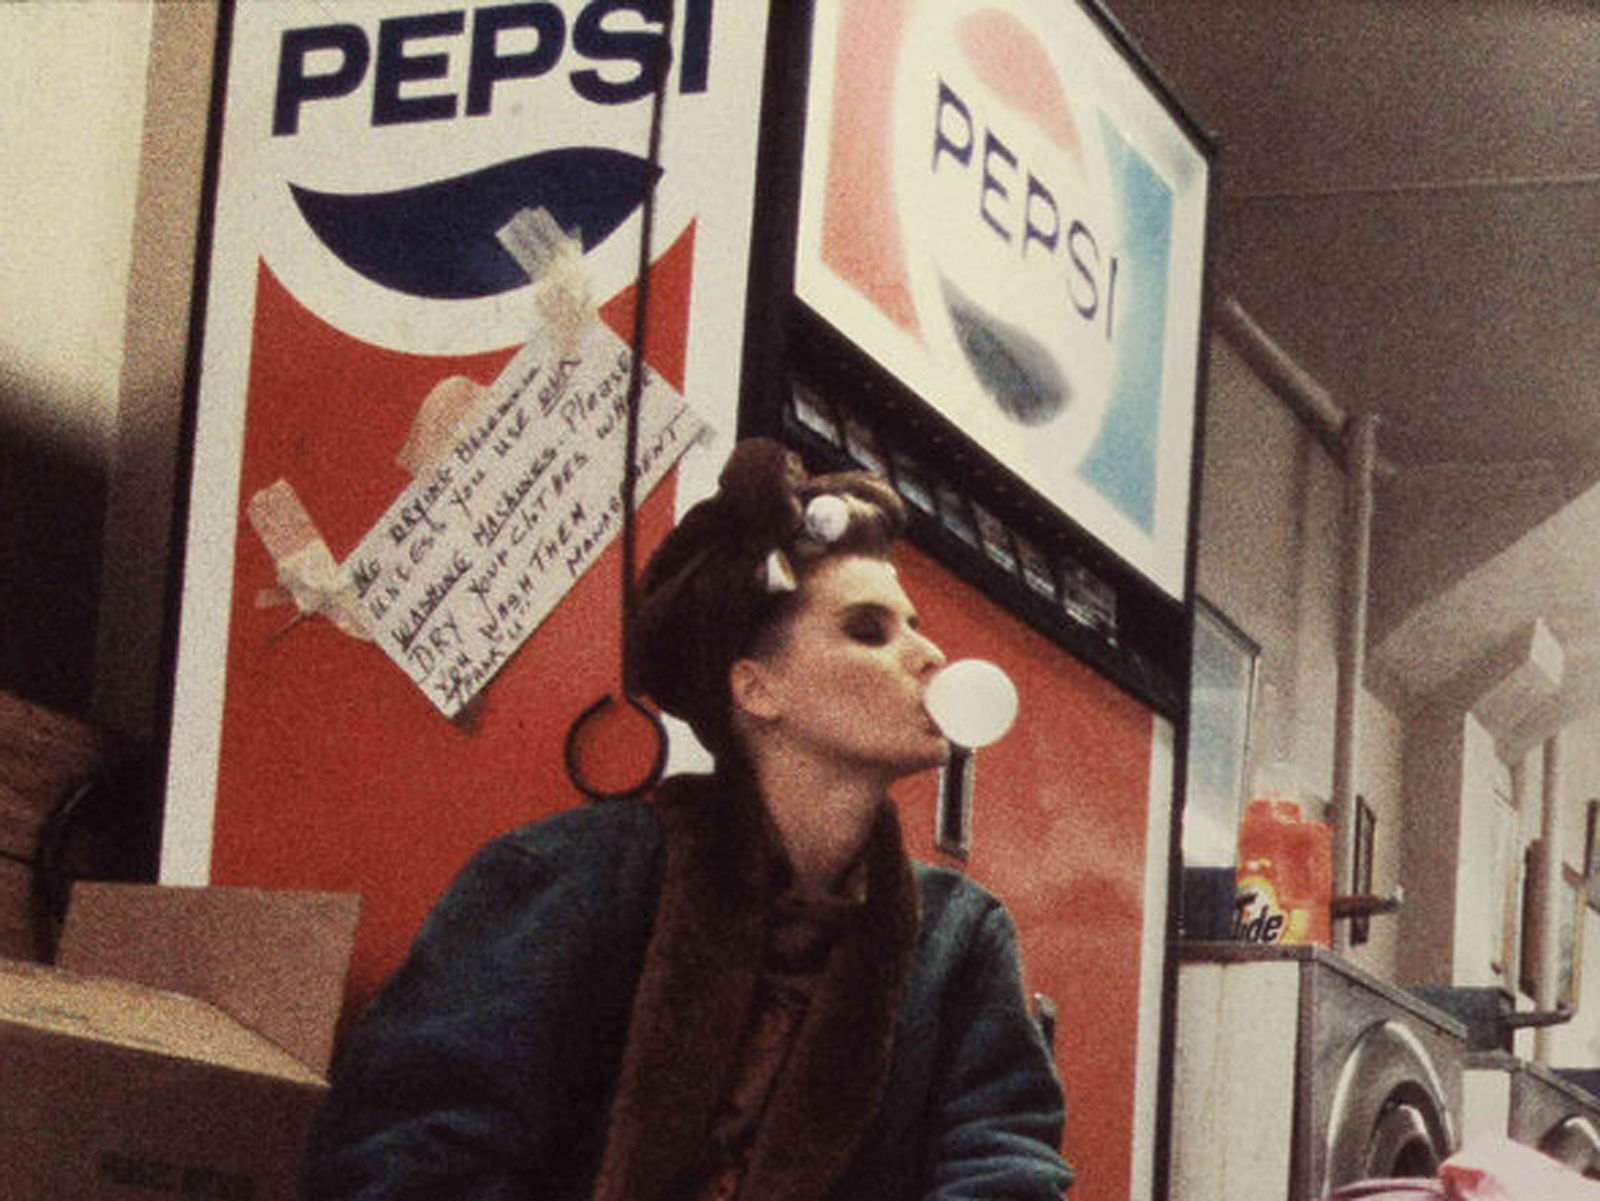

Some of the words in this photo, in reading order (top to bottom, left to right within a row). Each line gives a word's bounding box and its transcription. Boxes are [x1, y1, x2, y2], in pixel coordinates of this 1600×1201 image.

[271, 0, 714, 137] PEPSI
[931, 80, 1118, 342] PEPSI
[388, 549, 474, 653] WASHING
[408, 611, 464, 677] DRY
